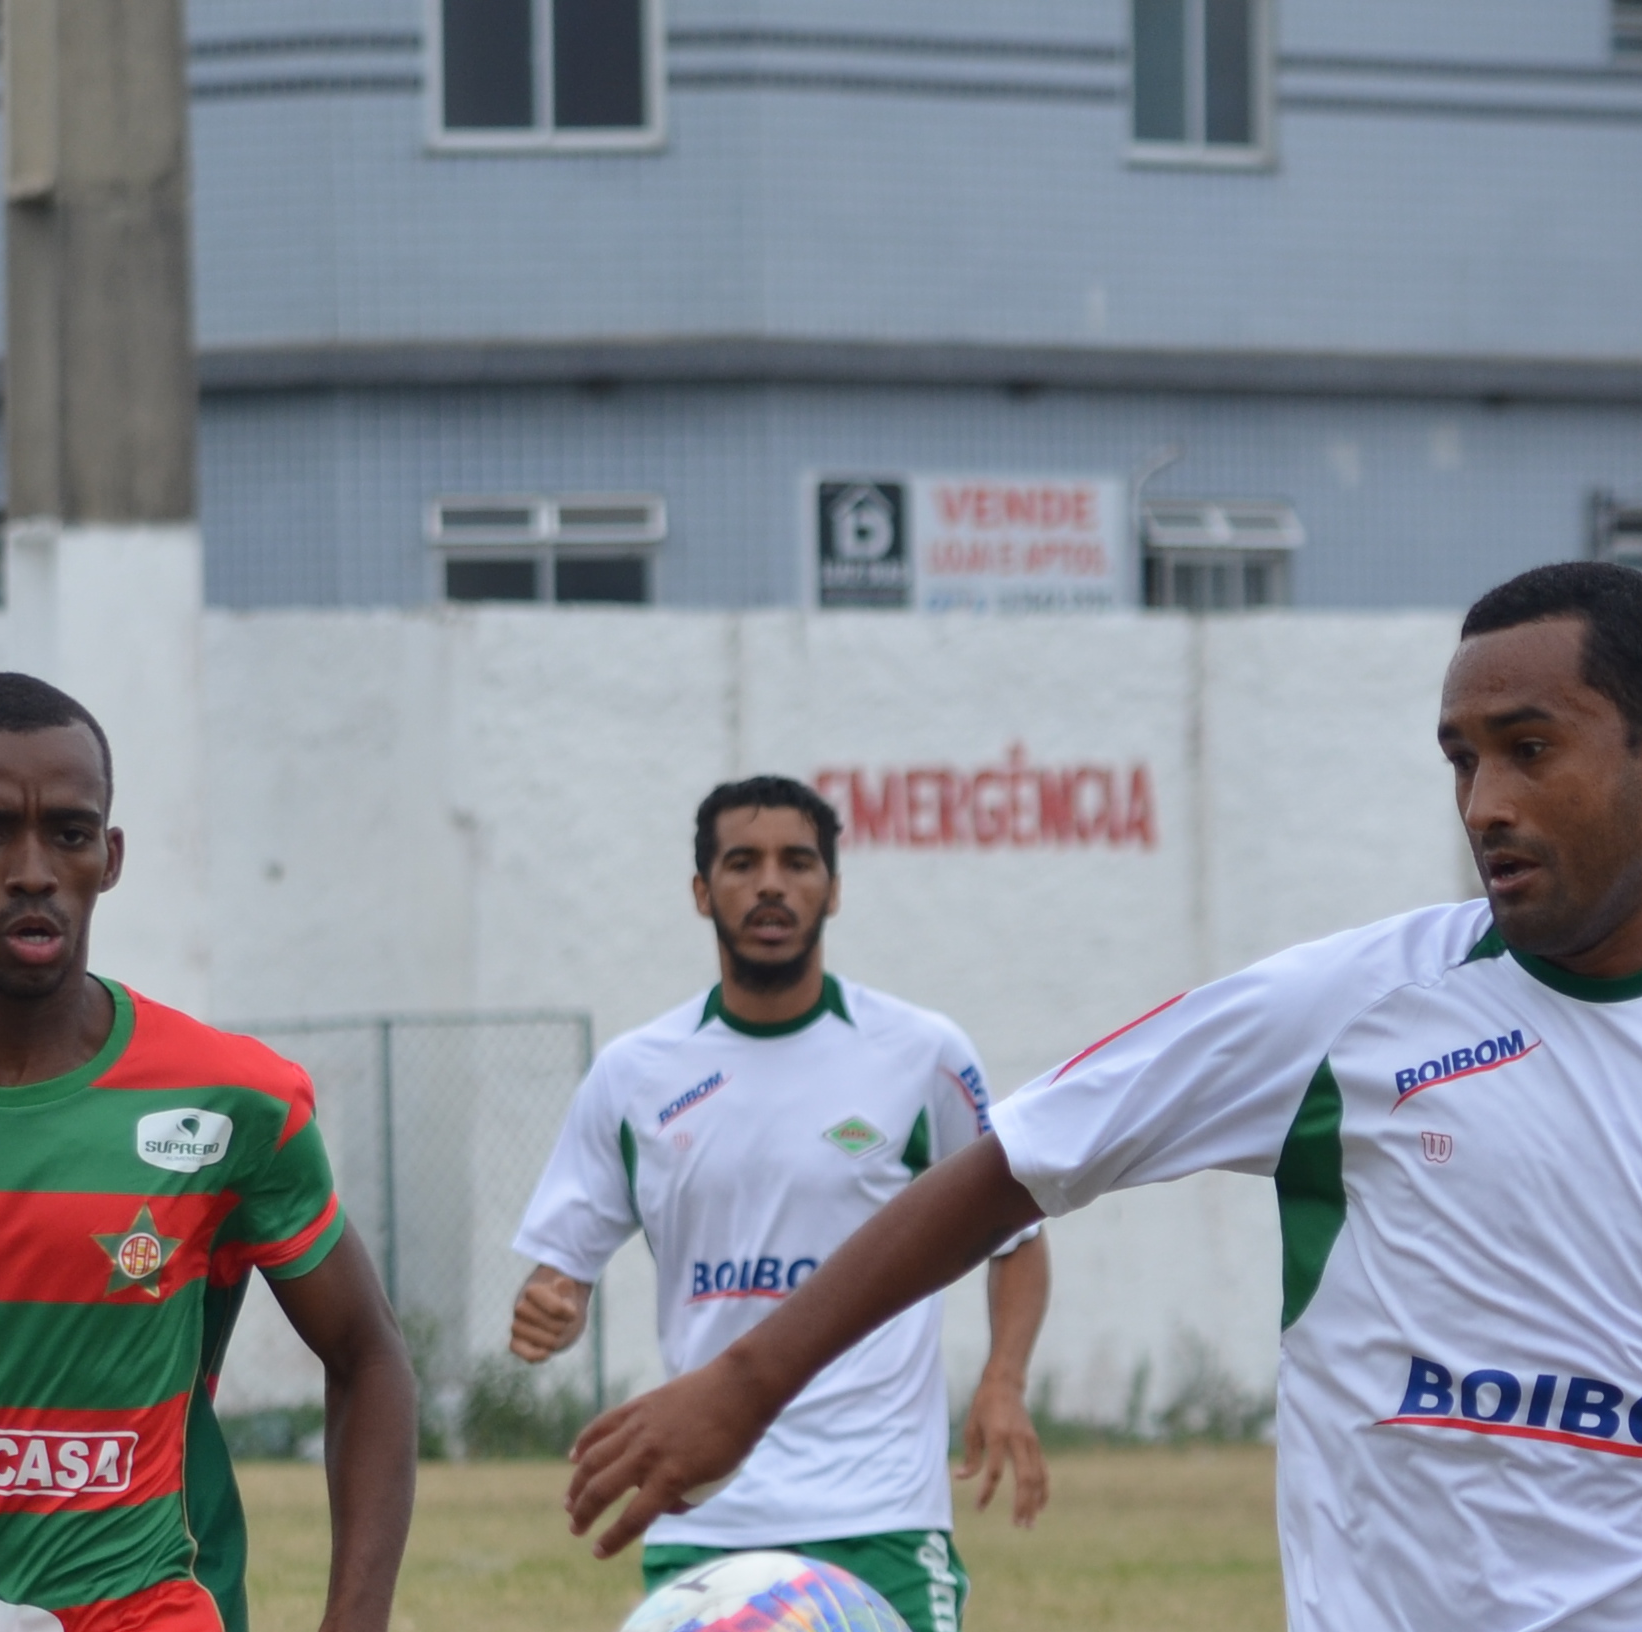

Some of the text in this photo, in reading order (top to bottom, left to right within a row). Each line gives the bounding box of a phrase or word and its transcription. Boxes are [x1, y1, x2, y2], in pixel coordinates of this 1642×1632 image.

[934, 485, 1097, 529] VENDE
[1395, 1029, 1526, 1096] BOIBOM
[659, 1071, 724, 1127] BOIBOM
[692, 1257, 818, 1298] BOIBO
